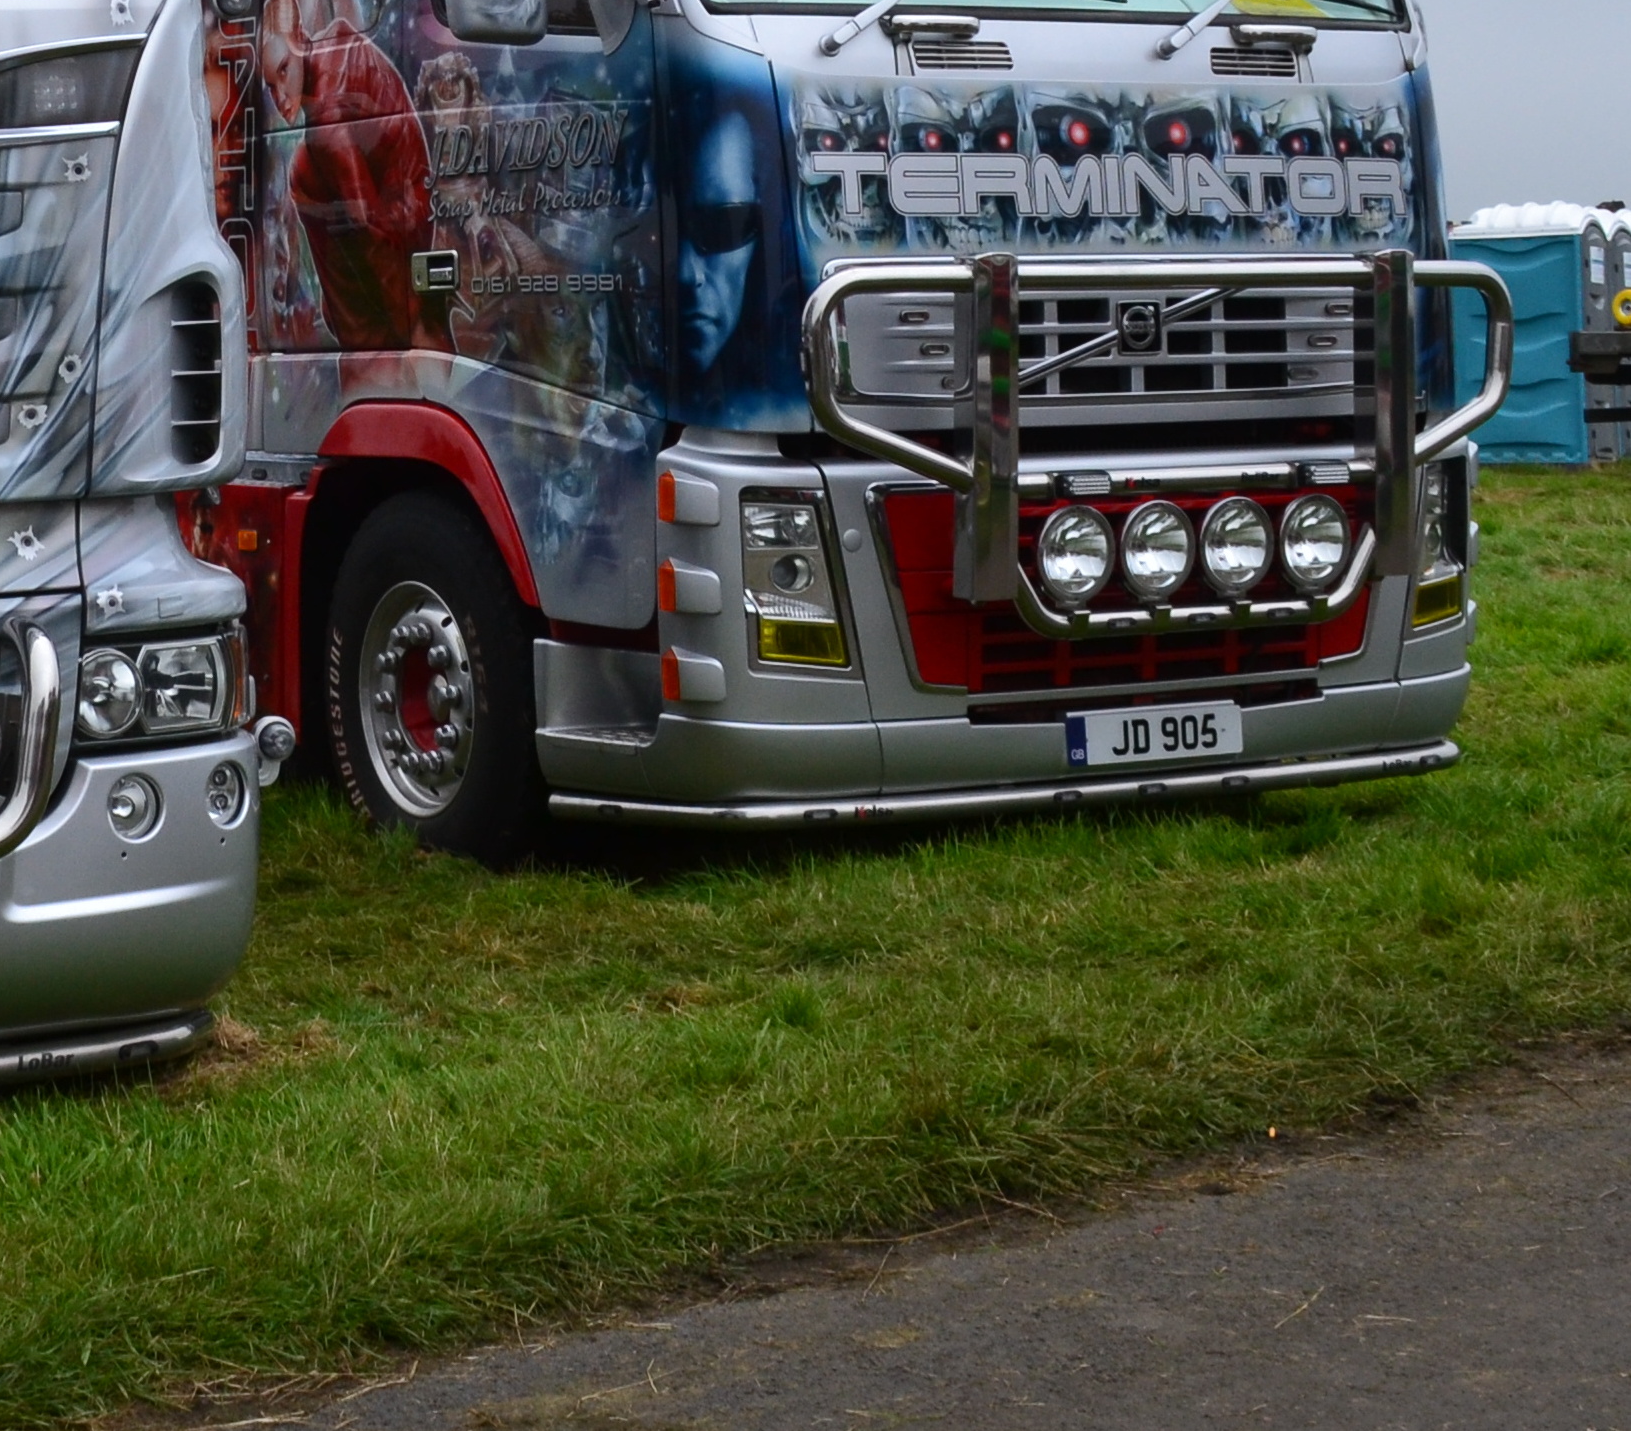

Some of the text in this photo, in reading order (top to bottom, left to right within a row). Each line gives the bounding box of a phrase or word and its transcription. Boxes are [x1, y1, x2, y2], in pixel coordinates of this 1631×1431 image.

[812, 153, 1410, 218] TERMINATOR
[427, 188, 474, 226] Scrap
[479, 180, 527, 217] Metal
[471, 273, 623, 293] 0161 928 9981
[1112, 713, 1218, 755] JD 905
[1071, 748, 1085, 760] GB
[18, 1051, 74, 1070] LoBar
